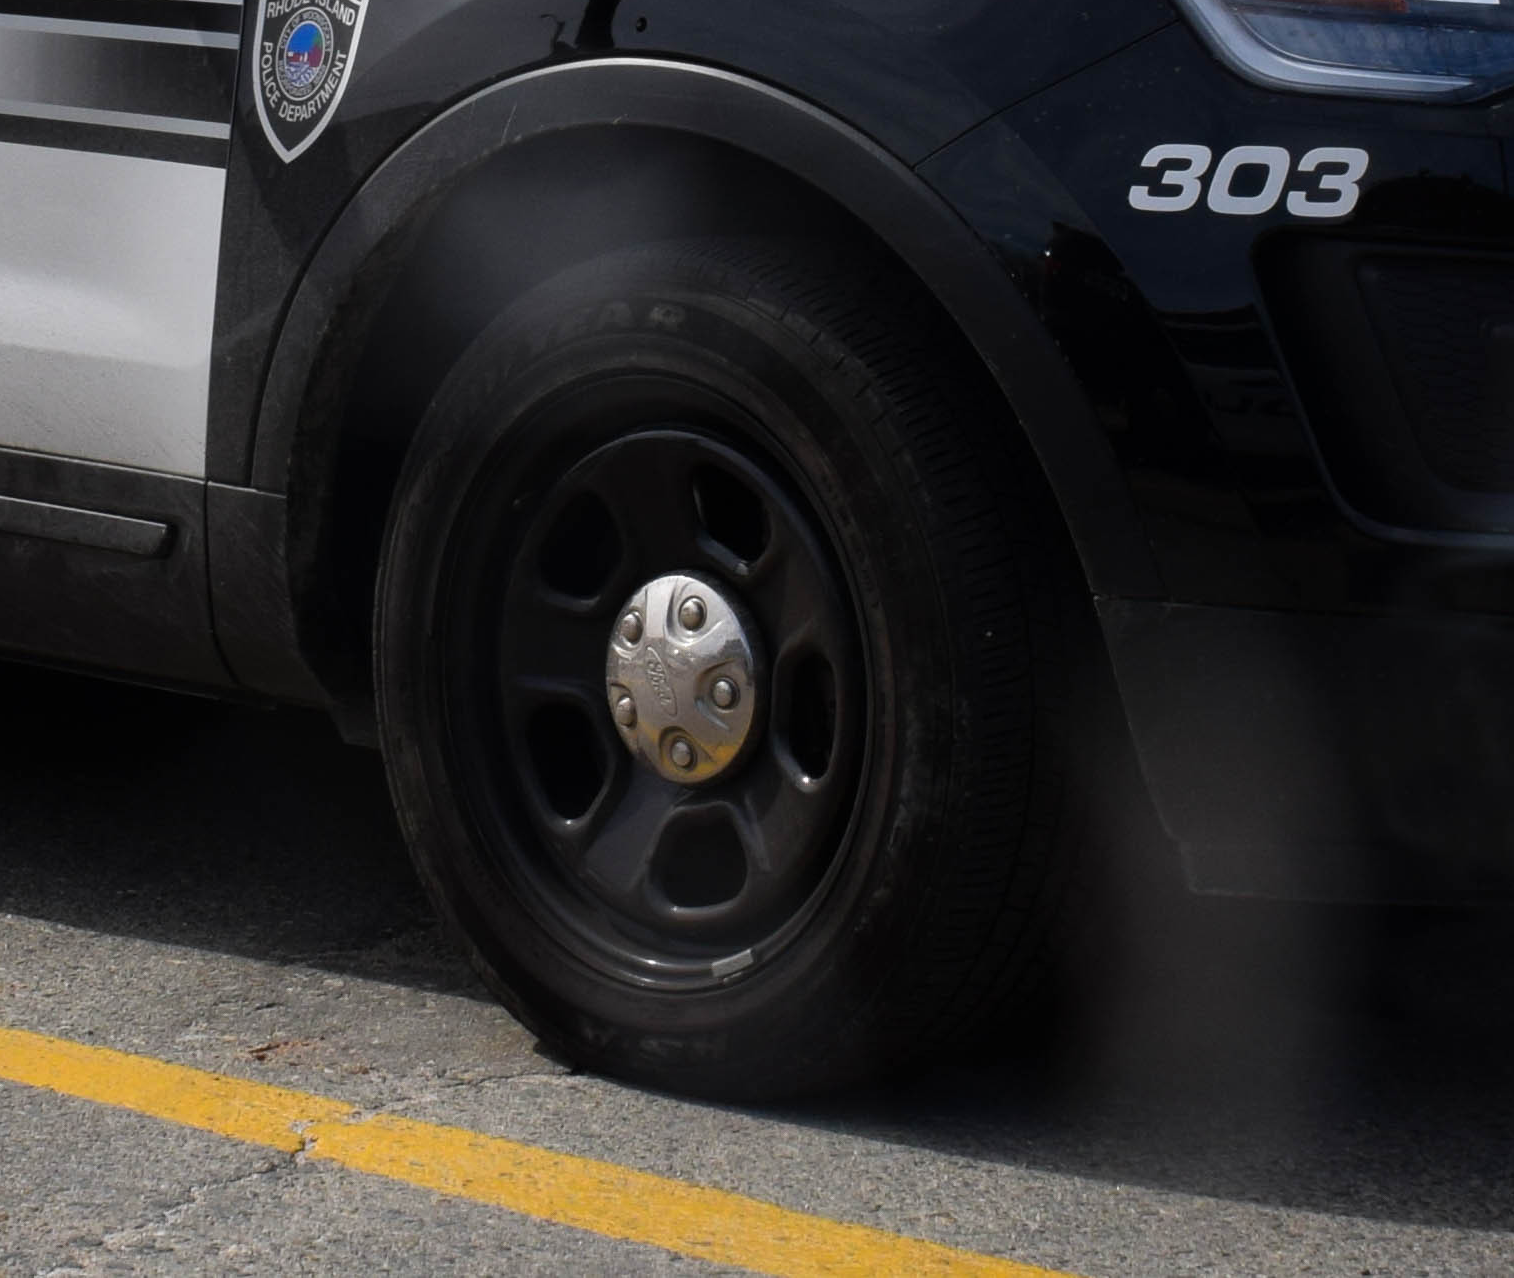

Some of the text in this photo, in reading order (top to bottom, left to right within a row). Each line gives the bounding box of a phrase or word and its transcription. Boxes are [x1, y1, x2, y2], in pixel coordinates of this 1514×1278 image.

[260, 41, 281, 109] POLICE
[278, 49, 348, 123] DEPARTMENT
[1128, 143, 1370, 218] 303
